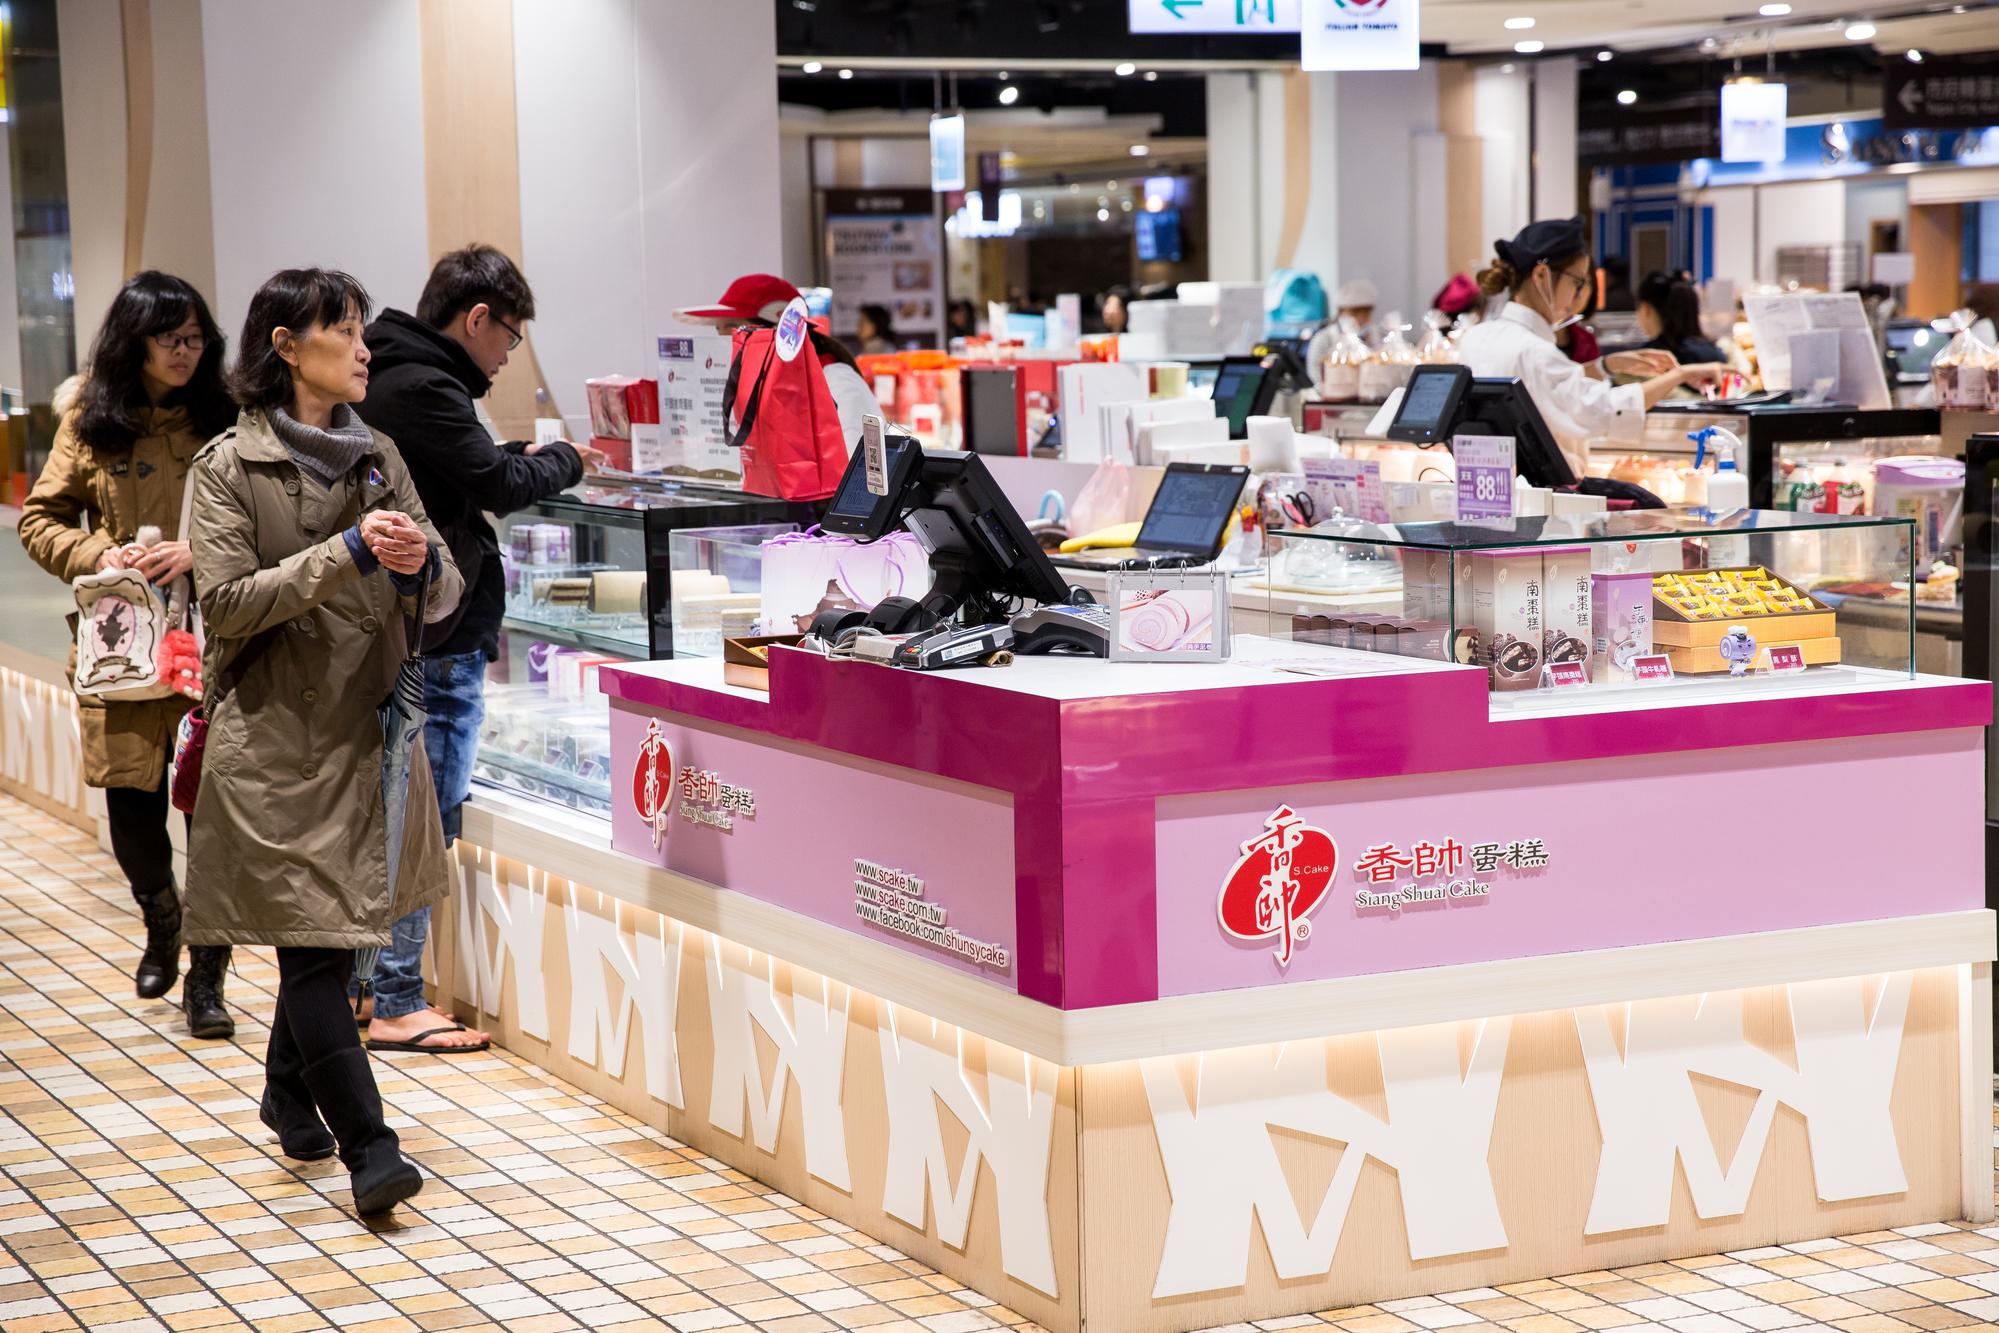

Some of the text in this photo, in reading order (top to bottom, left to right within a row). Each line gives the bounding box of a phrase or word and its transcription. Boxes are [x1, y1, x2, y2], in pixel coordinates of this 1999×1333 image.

[1476, 475, 1495, 501] 88
[1526, 580, 1540, 631] 南棗糕
[1576, 576, 1589, 627] 南棗糕
[678, 767, 752, 814] 香帥蛋糕
[854, 860, 919, 894] www.scake.tw
[1356, 838, 1550, 882] 香帥蛋糕
[854, 882, 942, 923] www.scake.com.tw
[1358, 879, 1490, 910] Siang Shuai Cake
[855, 902, 1005, 966] www.facebook.com/shunsycake
